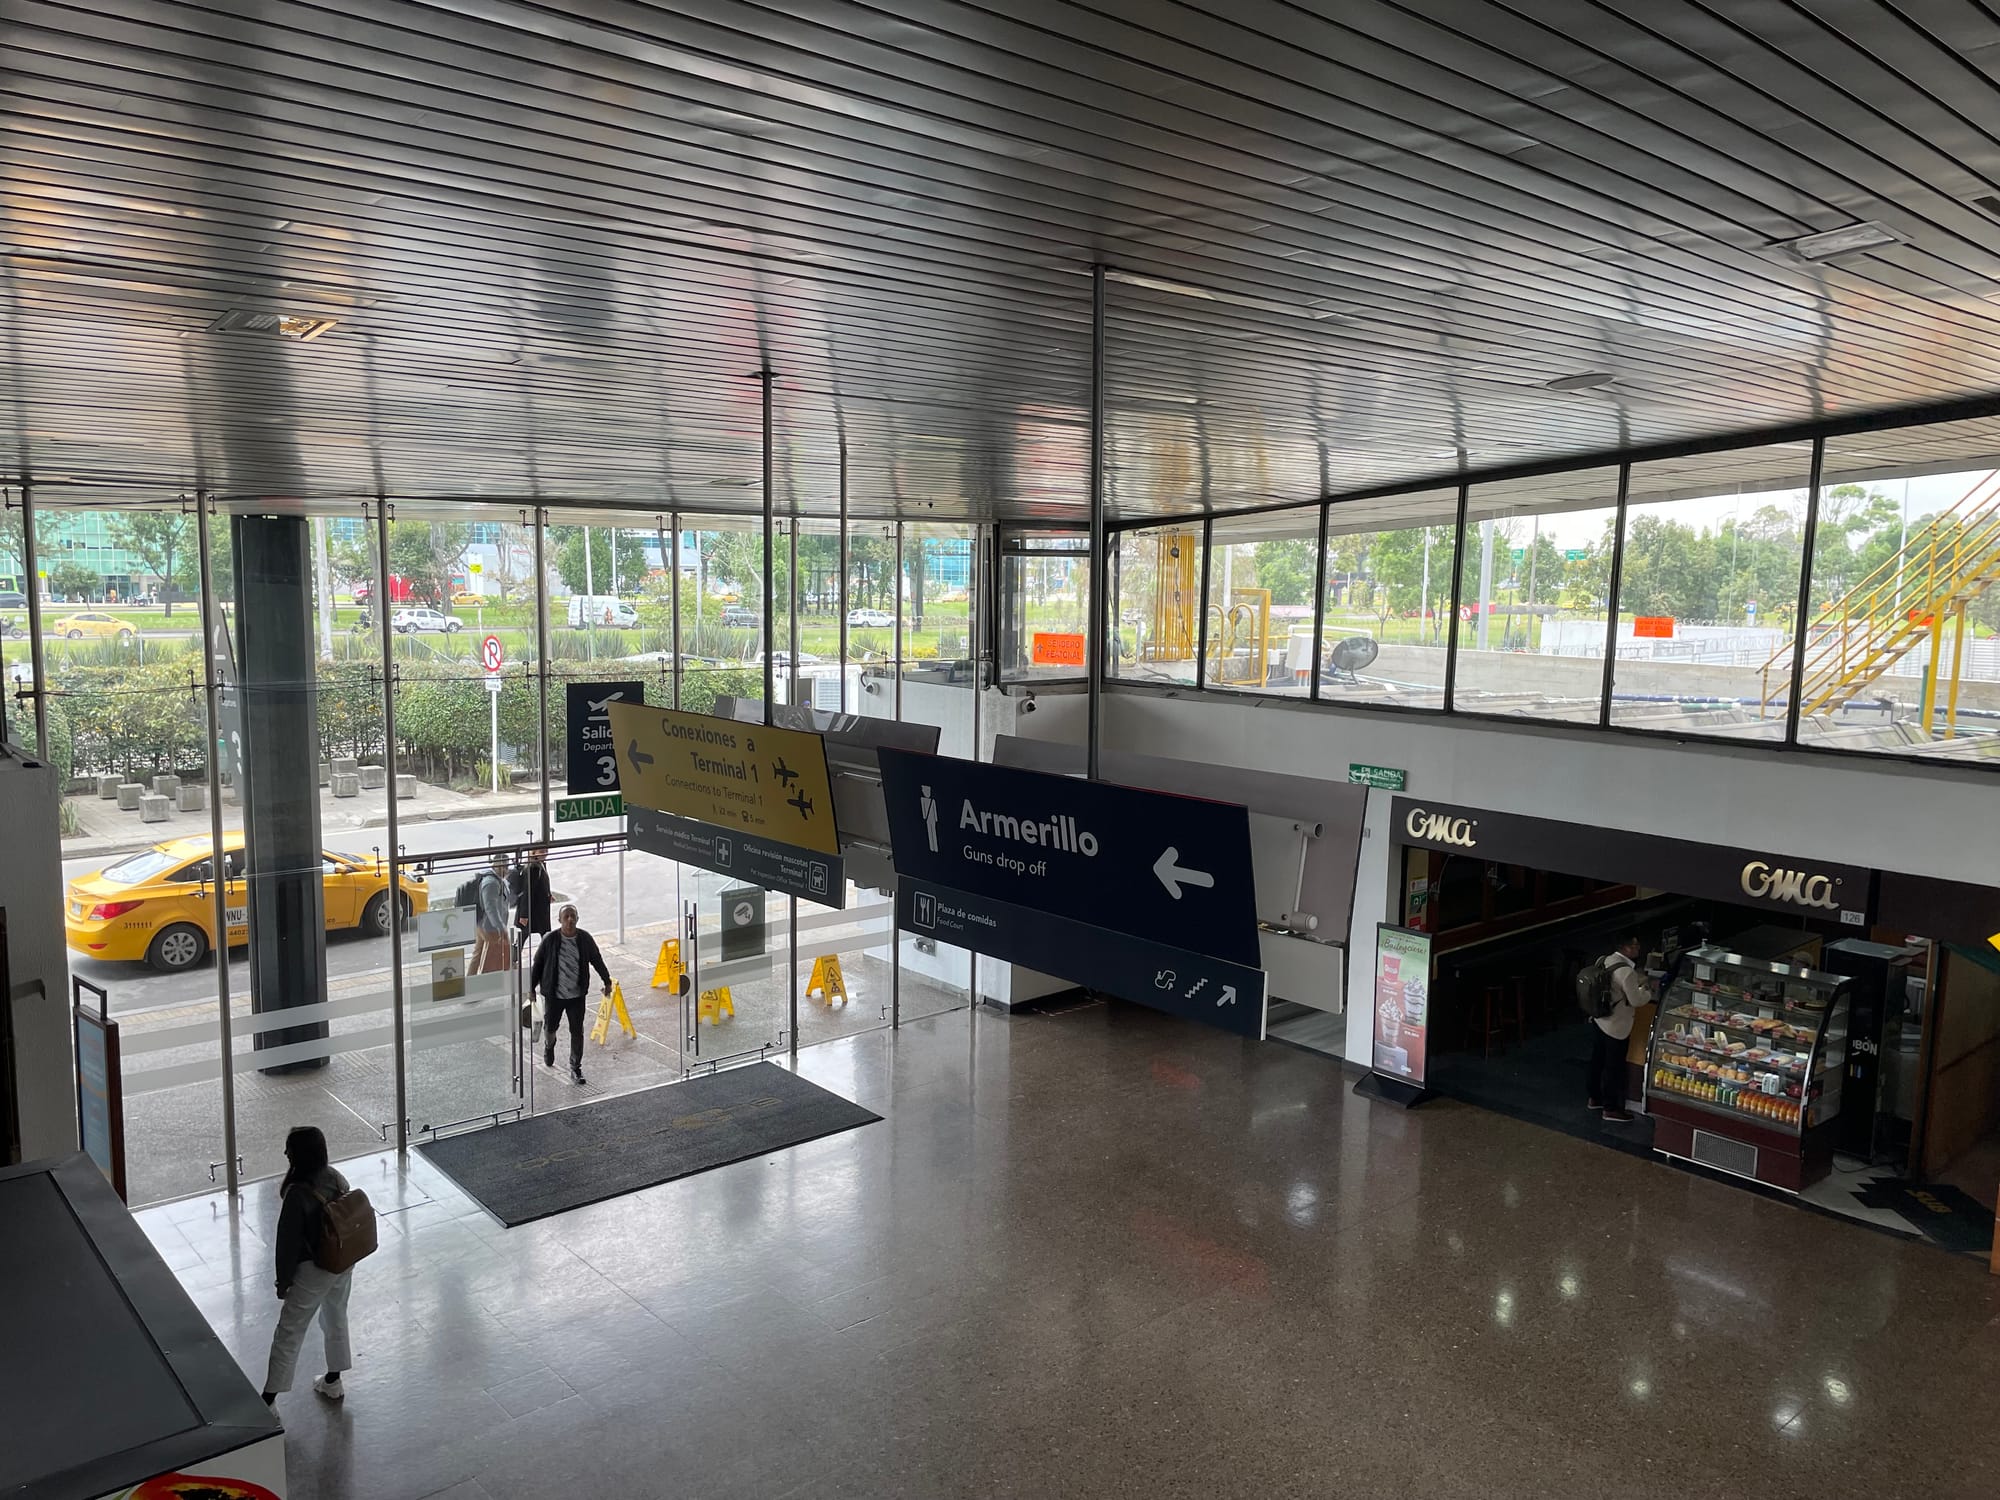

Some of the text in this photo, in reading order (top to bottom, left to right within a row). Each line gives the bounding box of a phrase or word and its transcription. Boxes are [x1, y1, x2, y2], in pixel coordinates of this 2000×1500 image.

[489, 641, 498, 665] P
[662, 718, 755, 752] Conexiones a
[596, 755, 617, 786] 3
[690, 751, 759, 784] Terminal 1
[665, 773, 711, 796] Connections
[712, 785, 722, 798] to
[722, 786, 756, 805] Terminal
[559, 797, 616, 820] SALIDA
[959, 798, 1099, 857] Armerillo
[963, 845, 1047, 877] Guns drop off
[937, 902, 997, 927] Plaza de comidas
[1843, 912, 1861, 924] 126
